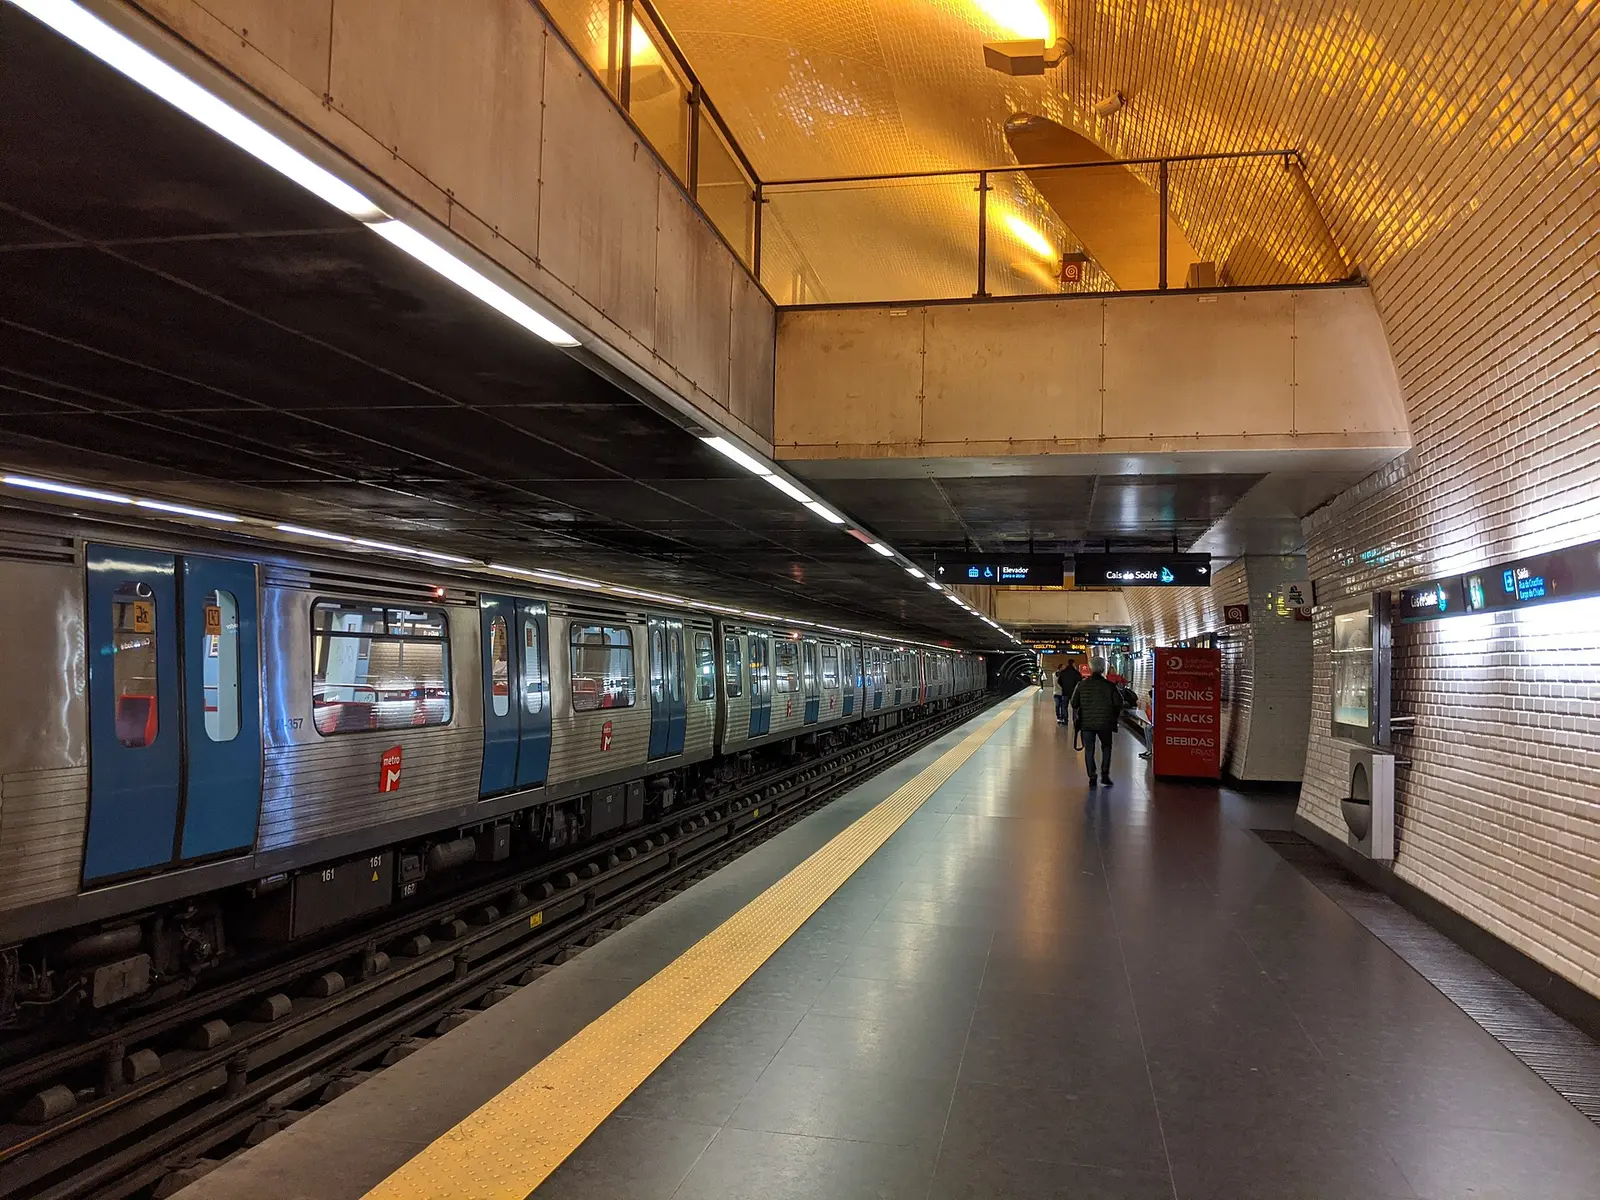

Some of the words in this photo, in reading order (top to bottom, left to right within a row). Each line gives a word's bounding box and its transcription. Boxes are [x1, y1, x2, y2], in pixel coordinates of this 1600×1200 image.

[1002, 566, 1029, 574] Elevador
[1106, 571, 1122, 579] Cais
[1122, 571, 1135, 580] do
[1135, 570, 1158, 579] Sodré
[1166, 689, 1214, 701] DRINKS
[1166, 712, 1213, 724] SNACKS
[1165, 735, 1214, 747] BEBIDAS
[383, 756, 400, 767] metro
[369, 855, 382, 868] 161
[321, 868, 335, 882] 161
